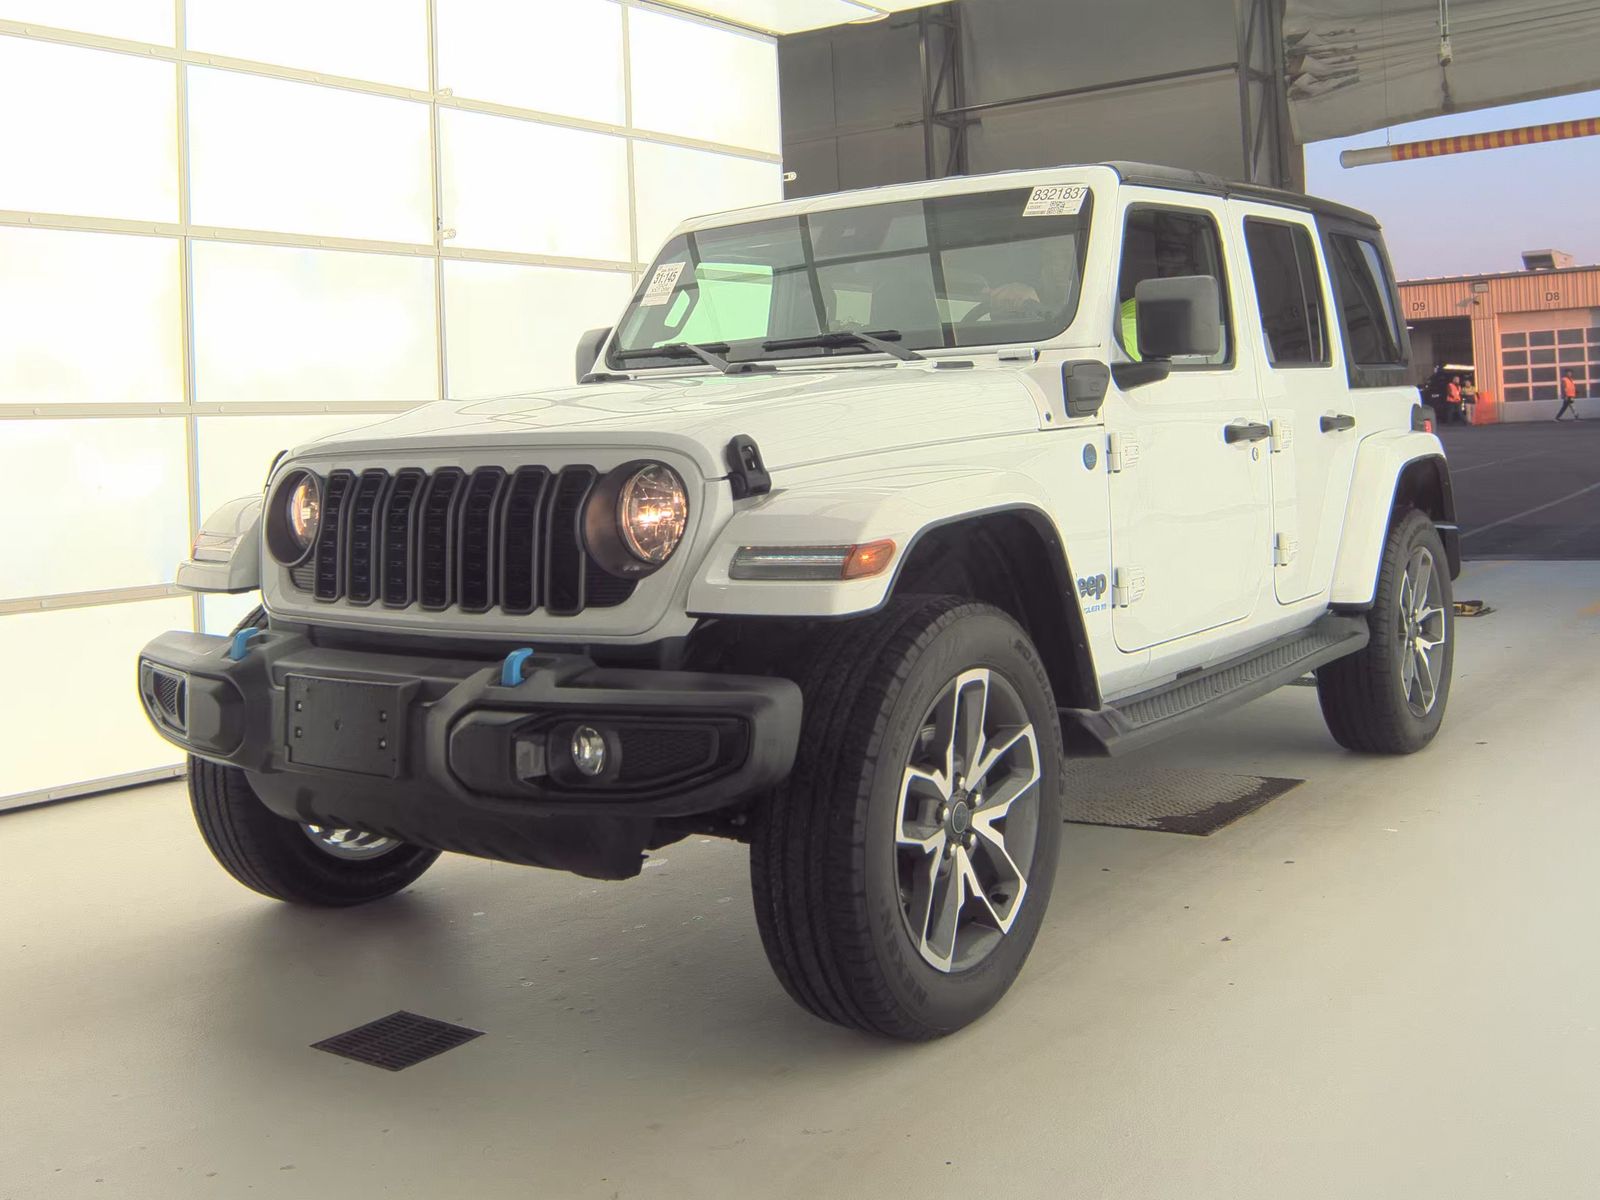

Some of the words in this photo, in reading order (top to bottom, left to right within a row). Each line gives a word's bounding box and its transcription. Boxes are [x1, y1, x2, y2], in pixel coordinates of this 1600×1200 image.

[1032, 186, 1089, 201] 8321837
[1545, 291, 1560, 302] D8
[1412, 302, 1426, 312] D9
[1077, 573, 1107, 600] eep
